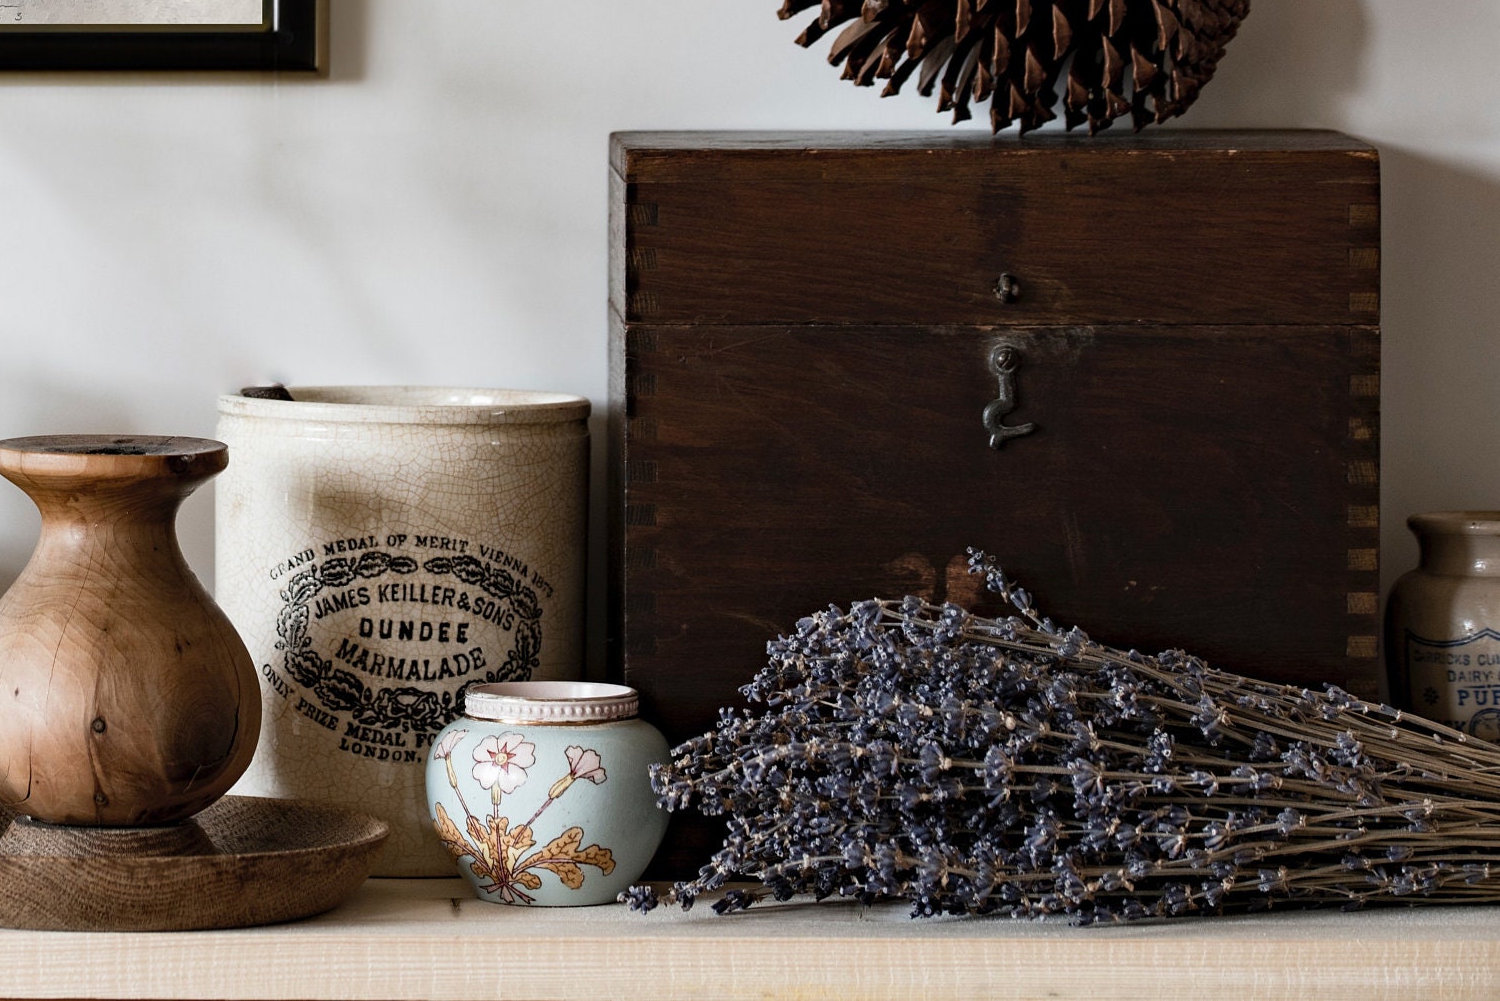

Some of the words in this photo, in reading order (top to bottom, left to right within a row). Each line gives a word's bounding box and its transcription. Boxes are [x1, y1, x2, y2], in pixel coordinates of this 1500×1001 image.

[270, 548, 315, 580] GRAND
[323, 536, 378, 555] MEDAL
[386, 534, 407, 547] OF
[415, 535, 469, 553] MERIT
[480, 544, 528, 578] VIENNA
[315, 586, 370, 619] JAMES
[378, 584, 456, 607] KEILLER
[456, 592, 471, 612] &
[360, 618, 470, 644] DUNDEE
[335, 639, 486, 681] MARMALADE
[263, 664, 295, 699] ONLY
[295, 697, 339, 731] PRIZE
[344, 722, 406, 747] MEDAL
[415, 733, 437, 748] FO
